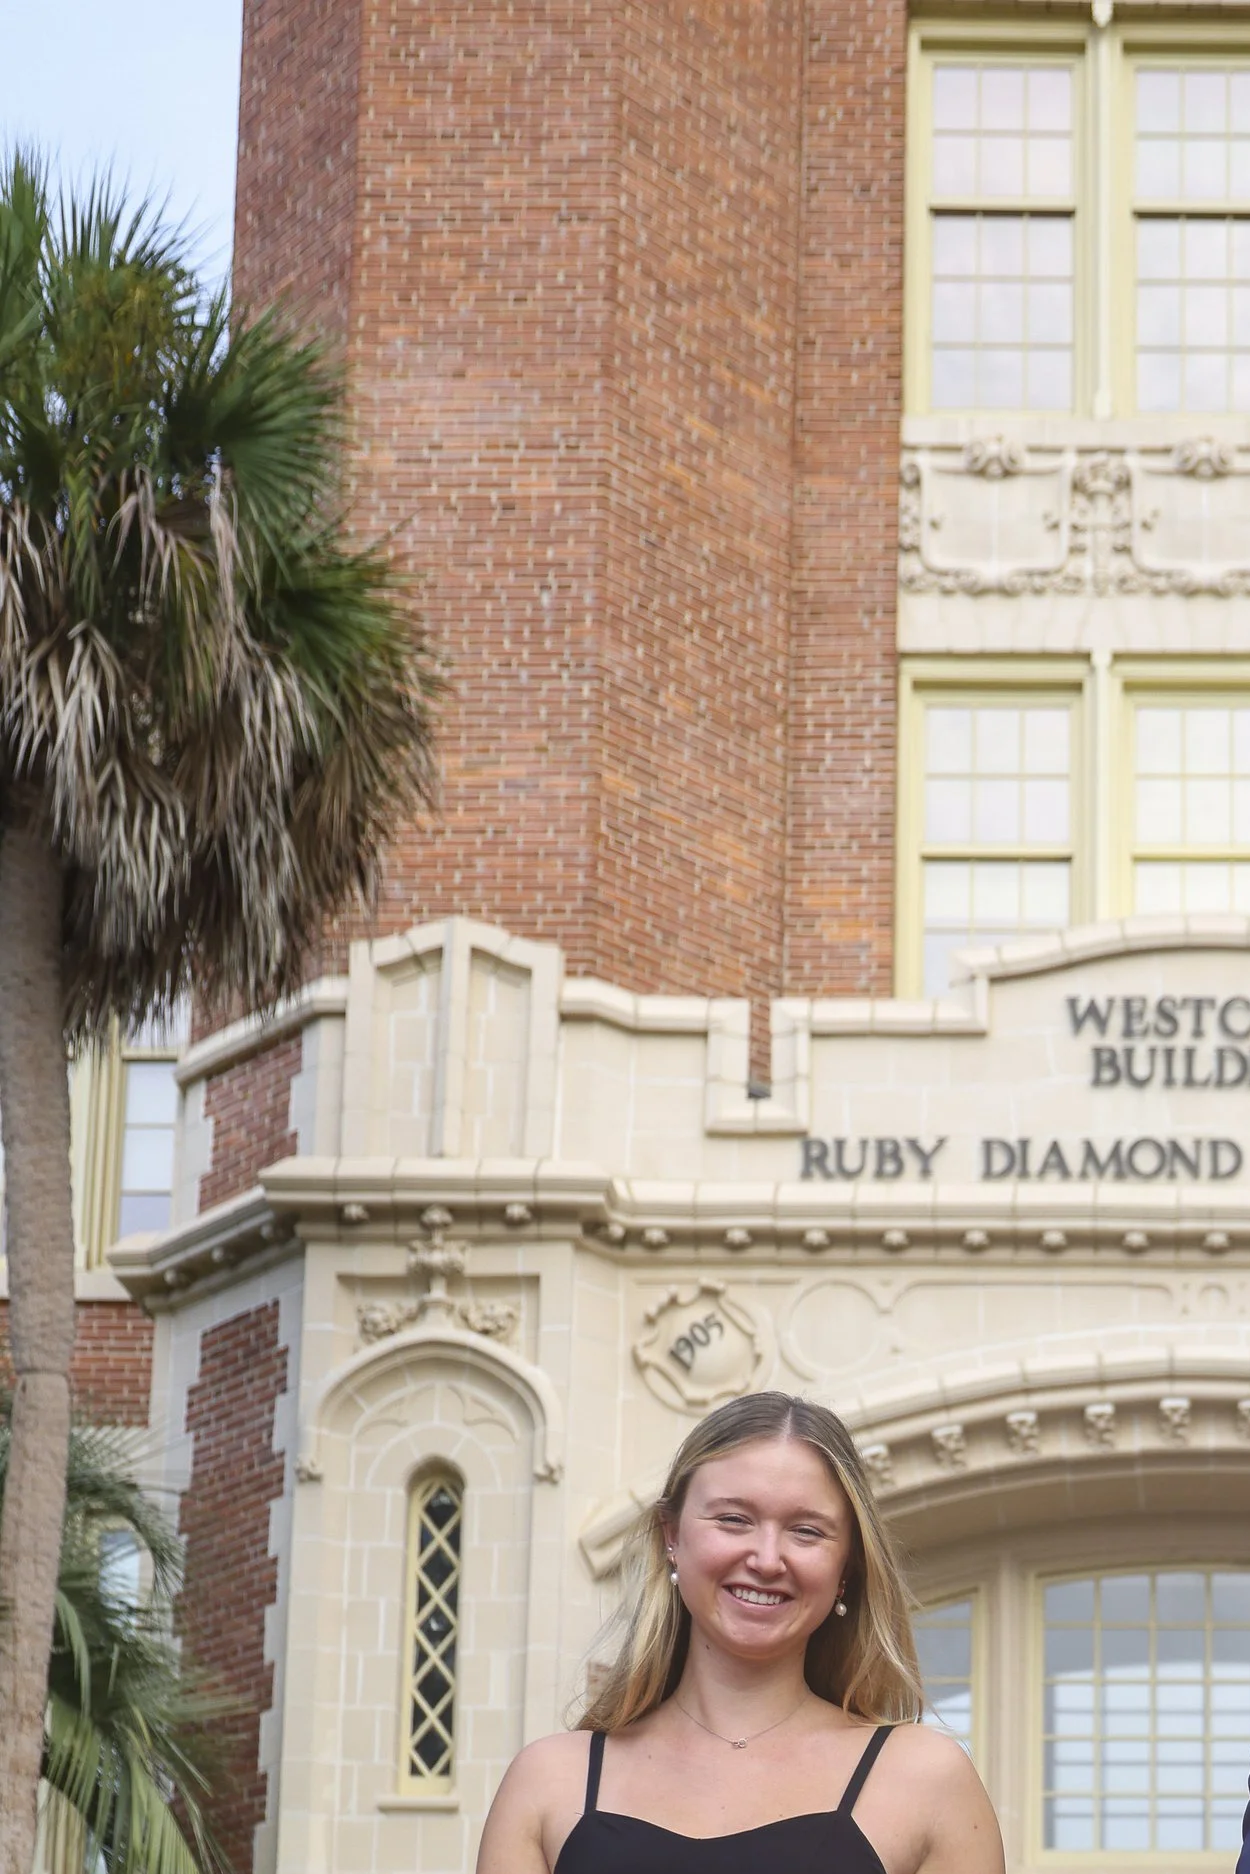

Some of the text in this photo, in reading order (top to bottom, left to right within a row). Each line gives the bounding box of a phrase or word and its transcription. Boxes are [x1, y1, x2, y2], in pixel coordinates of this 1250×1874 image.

[799, 1136, 946, 1180] RUBY
[982, 1137, 1244, 1181] DIAMOND
[668, 1311, 724, 1374] 1905
